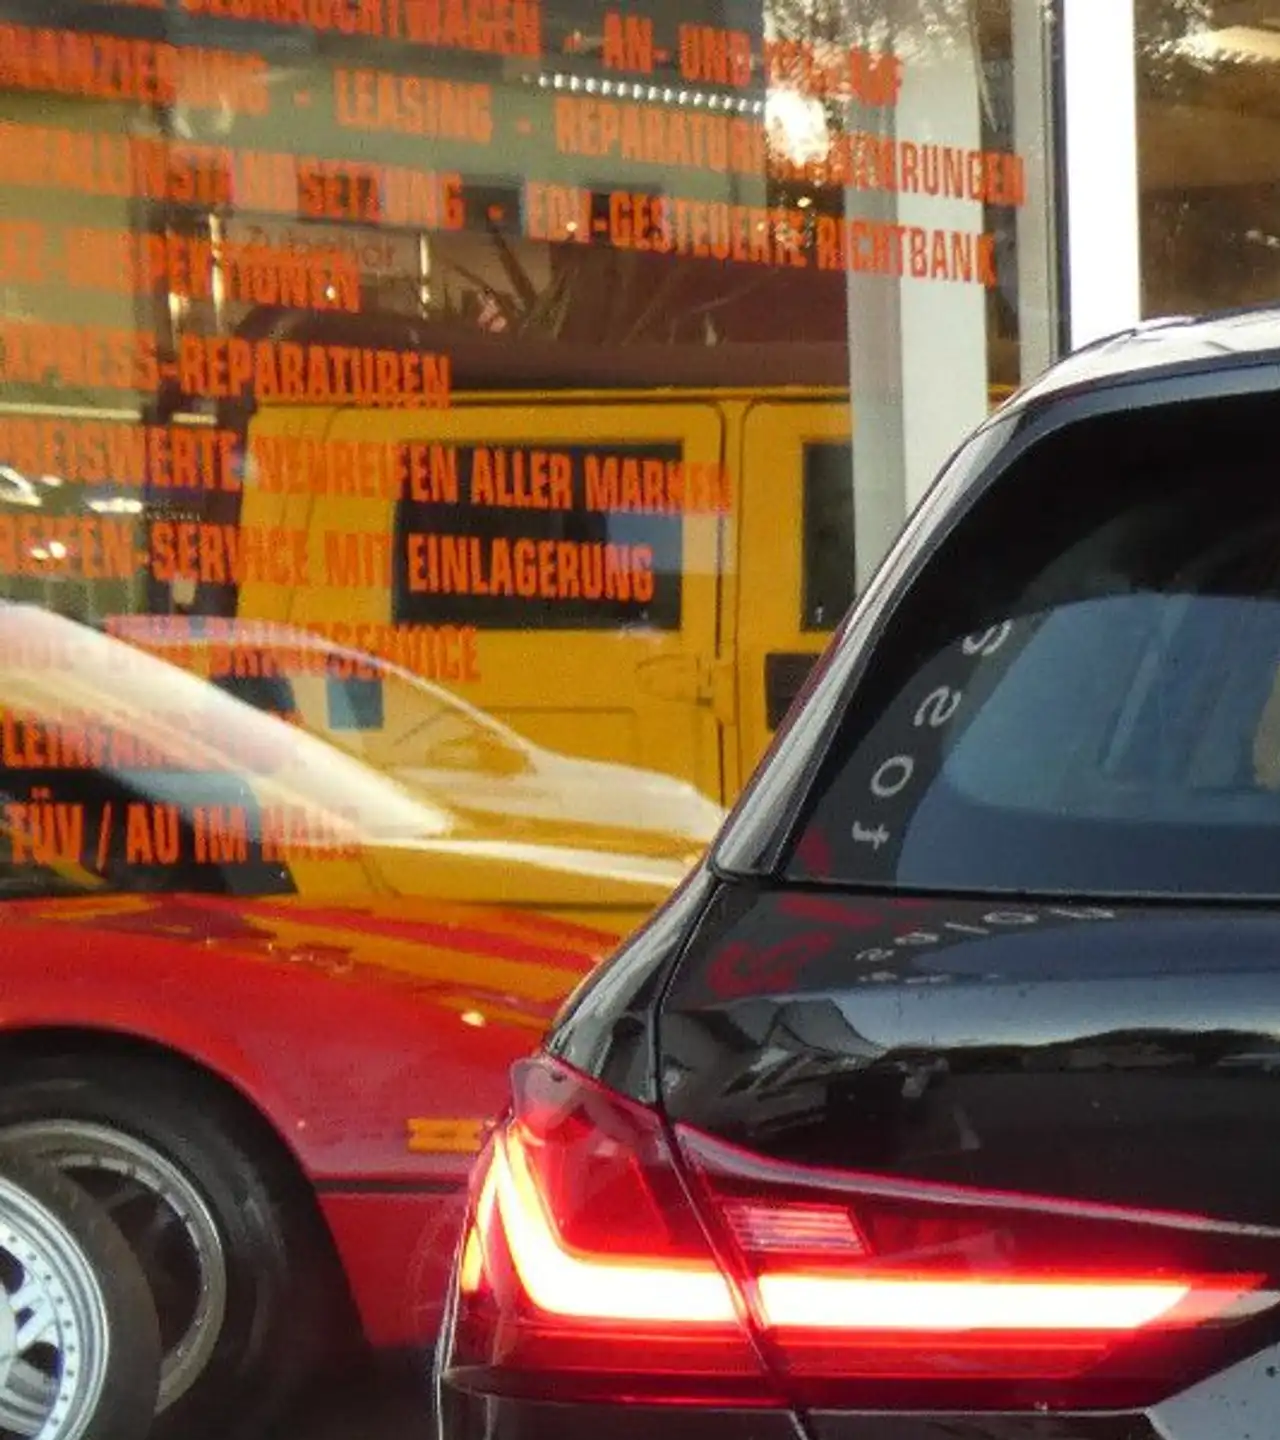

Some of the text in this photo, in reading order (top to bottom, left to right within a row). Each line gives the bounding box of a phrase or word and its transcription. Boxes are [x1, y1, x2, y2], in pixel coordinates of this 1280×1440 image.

[334, 67, 492, 144] LEASING
[816, 216, 997, 290] RICHTBANK
[470, 447, 573, 511] ALLER
[583, 454, 732, 519] MARKEN
[325, 531, 393, 588] MIT
[408, 532, 654, 603] EINLAGERUNG
[10, 788, 85, 867] TÜV
[126, 802, 183, 866] AU
[193, 804, 251, 865] IM
